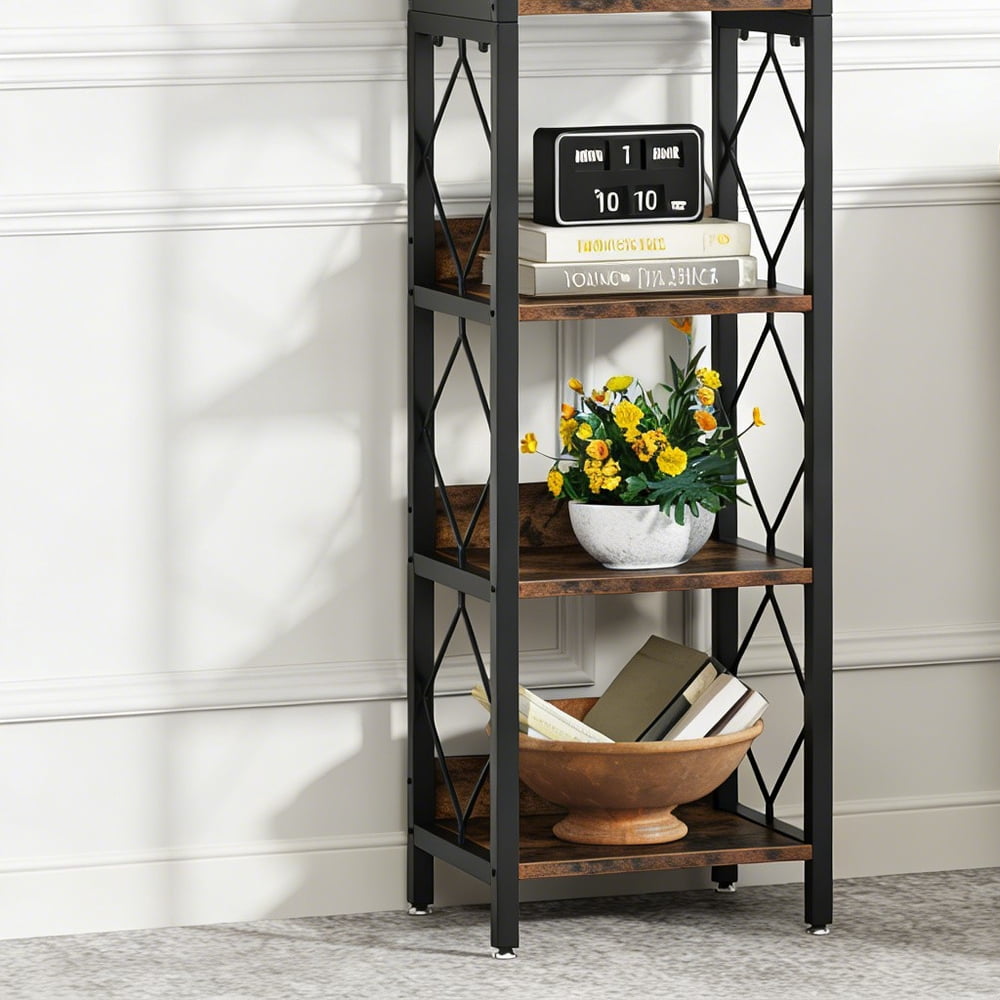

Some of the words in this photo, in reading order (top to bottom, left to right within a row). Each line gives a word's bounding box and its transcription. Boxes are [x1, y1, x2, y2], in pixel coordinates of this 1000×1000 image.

[622, 145, 630, 165] 1
[594, 189, 619, 213] 10
[633, 190, 657, 212] 10
